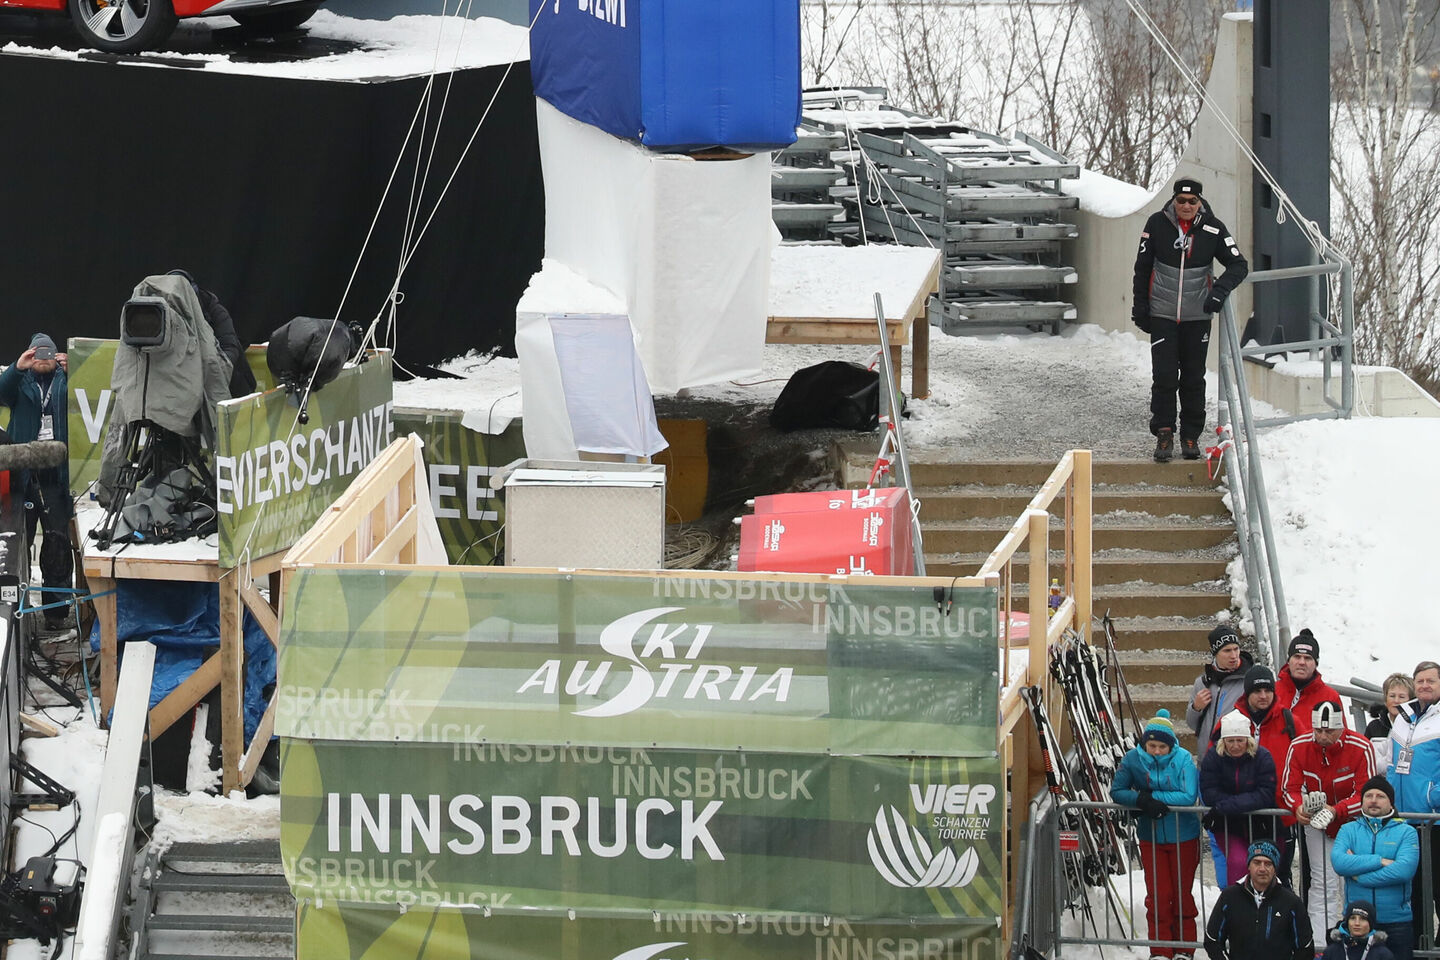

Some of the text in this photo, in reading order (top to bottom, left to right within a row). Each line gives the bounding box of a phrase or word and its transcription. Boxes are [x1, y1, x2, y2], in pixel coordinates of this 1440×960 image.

[612, 765, 813, 801] INNSBRUCK
[910, 783, 996, 814] VIER
[327, 792, 725, 861] INNSBRUCK
[932, 816, 991, 829] SCHANZEN
[938, 828, 988, 840] TOURNEE
